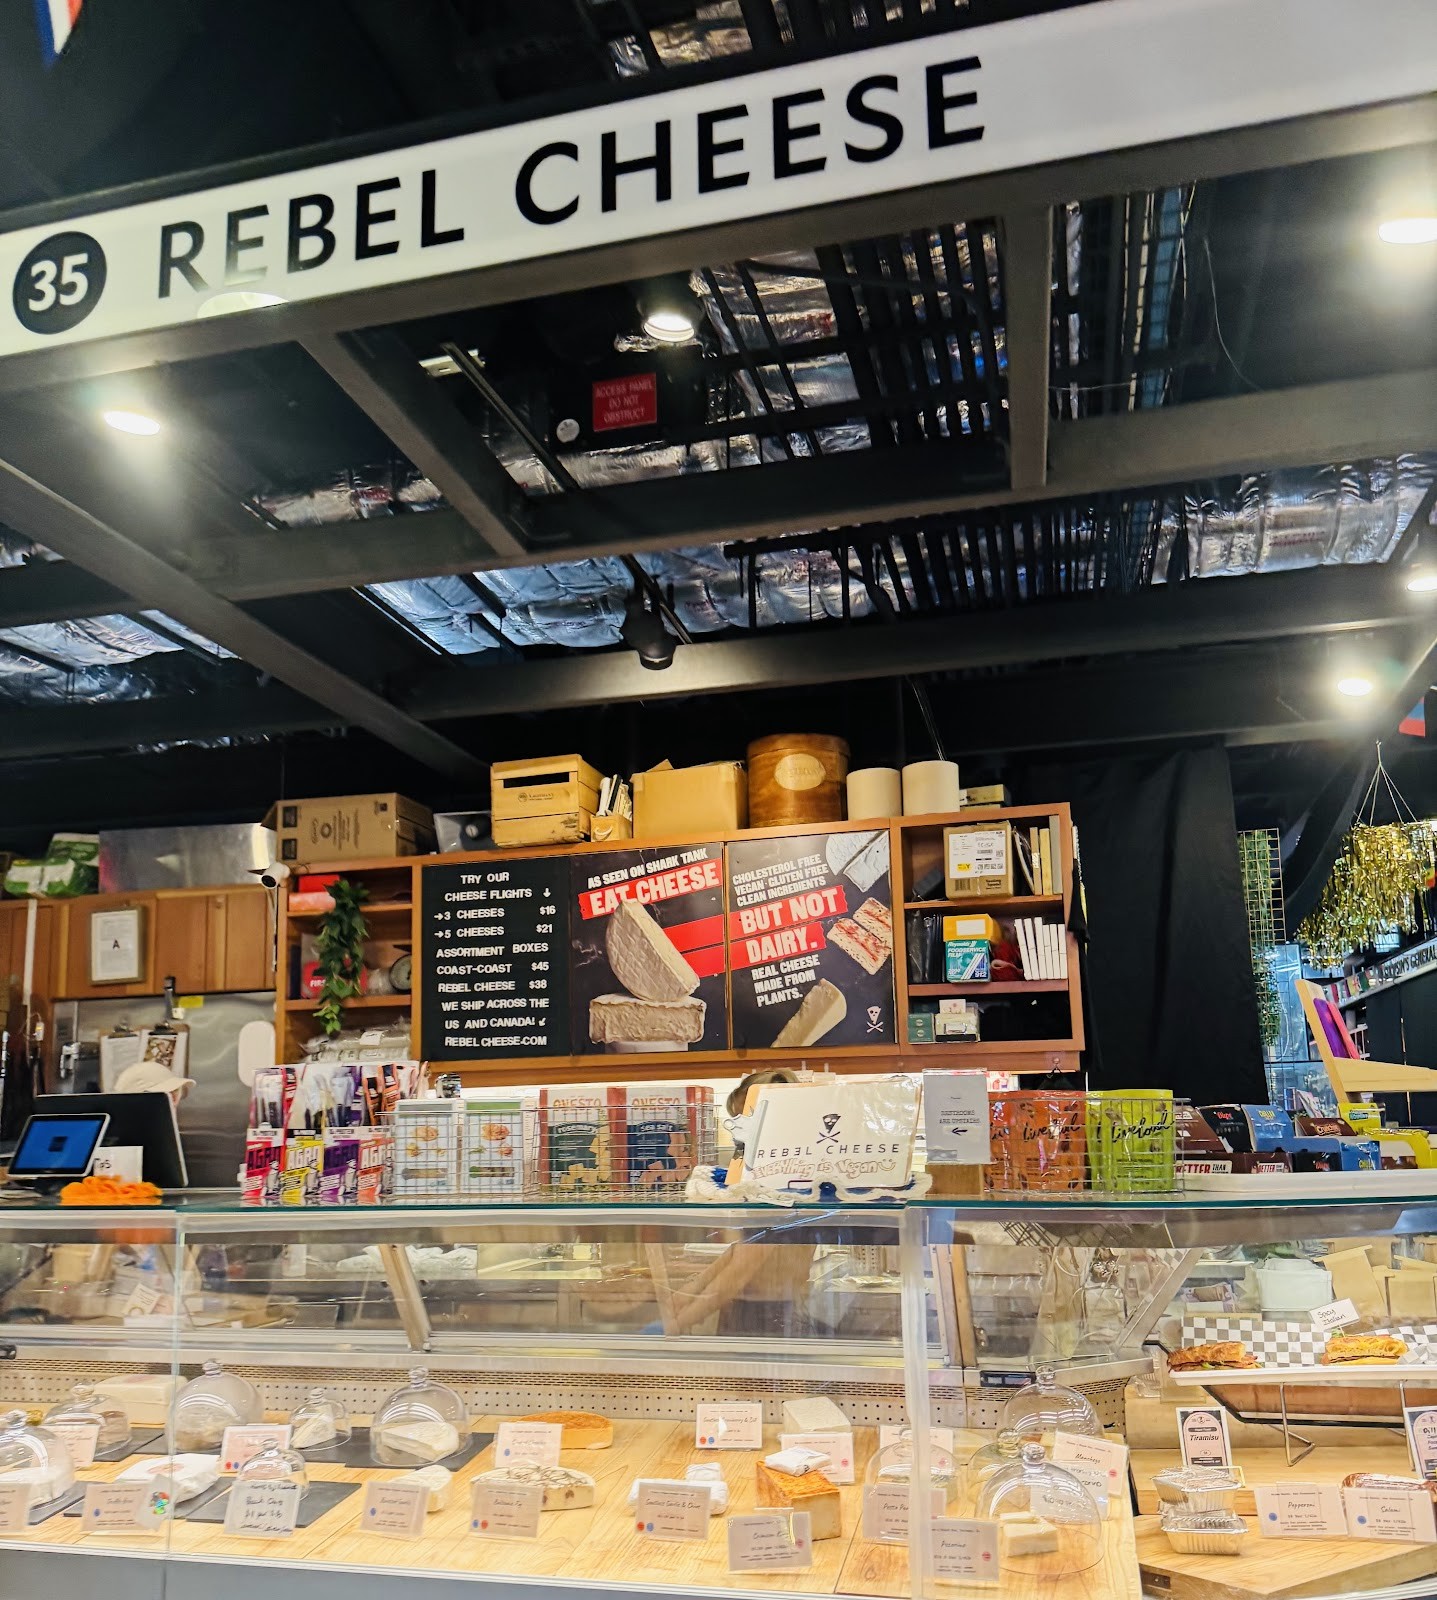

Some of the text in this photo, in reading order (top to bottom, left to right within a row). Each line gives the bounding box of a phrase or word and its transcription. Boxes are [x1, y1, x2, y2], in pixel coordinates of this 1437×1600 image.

[28, 55, 986, 312] 35 REBEL CHEESE
[623, 394, 640, 407] NOT
[587, 847, 709, 890] AS SEEN ON SHARK TANK
[732, 853, 822, 886] CHOLESTEROL FREE
[460, 872, 510, 884] TRY OUR
[734, 863, 829, 896] VEGAN GLUTEN FREE
[444, 888, 533, 902] CHEESE FLIGHTS
[589, 862, 720, 916] EAT CHEESE
[736, 875, 827, 907] CLEAN INGREDIENTS
[456, 908, 505, 920] CHEESES
[539, 905, 556, 916] $16
[739, 889, 840, 935] BUT NOT
[456, 926, 505, 938] CHEESES
[536, 923, 553, 934] $21
[112, 939, 121, 950] A
[435, 943, 549, 958] ASSORTMENT BOXES
[746, 925, 818, 964] DAIRY.
[436, 961, 549, 975] COAST-COAST $45
[751, 954, 820, 981] REAL CHEESE
[438, 980, 547, 993] REBEL CHEESE $38
[754, 970, 816, 994] MADE FROM
[441, 998, 549, 1012] WE SHIP ACROSS THE
[756, 987, 804, 1008] PLANTS.
[445, 1016, 535, 1030] US AND CANADA!
[444, 1037, 480, 1047] REBEL
[757, 1143, 900, 1159] REBEL CHEESE
